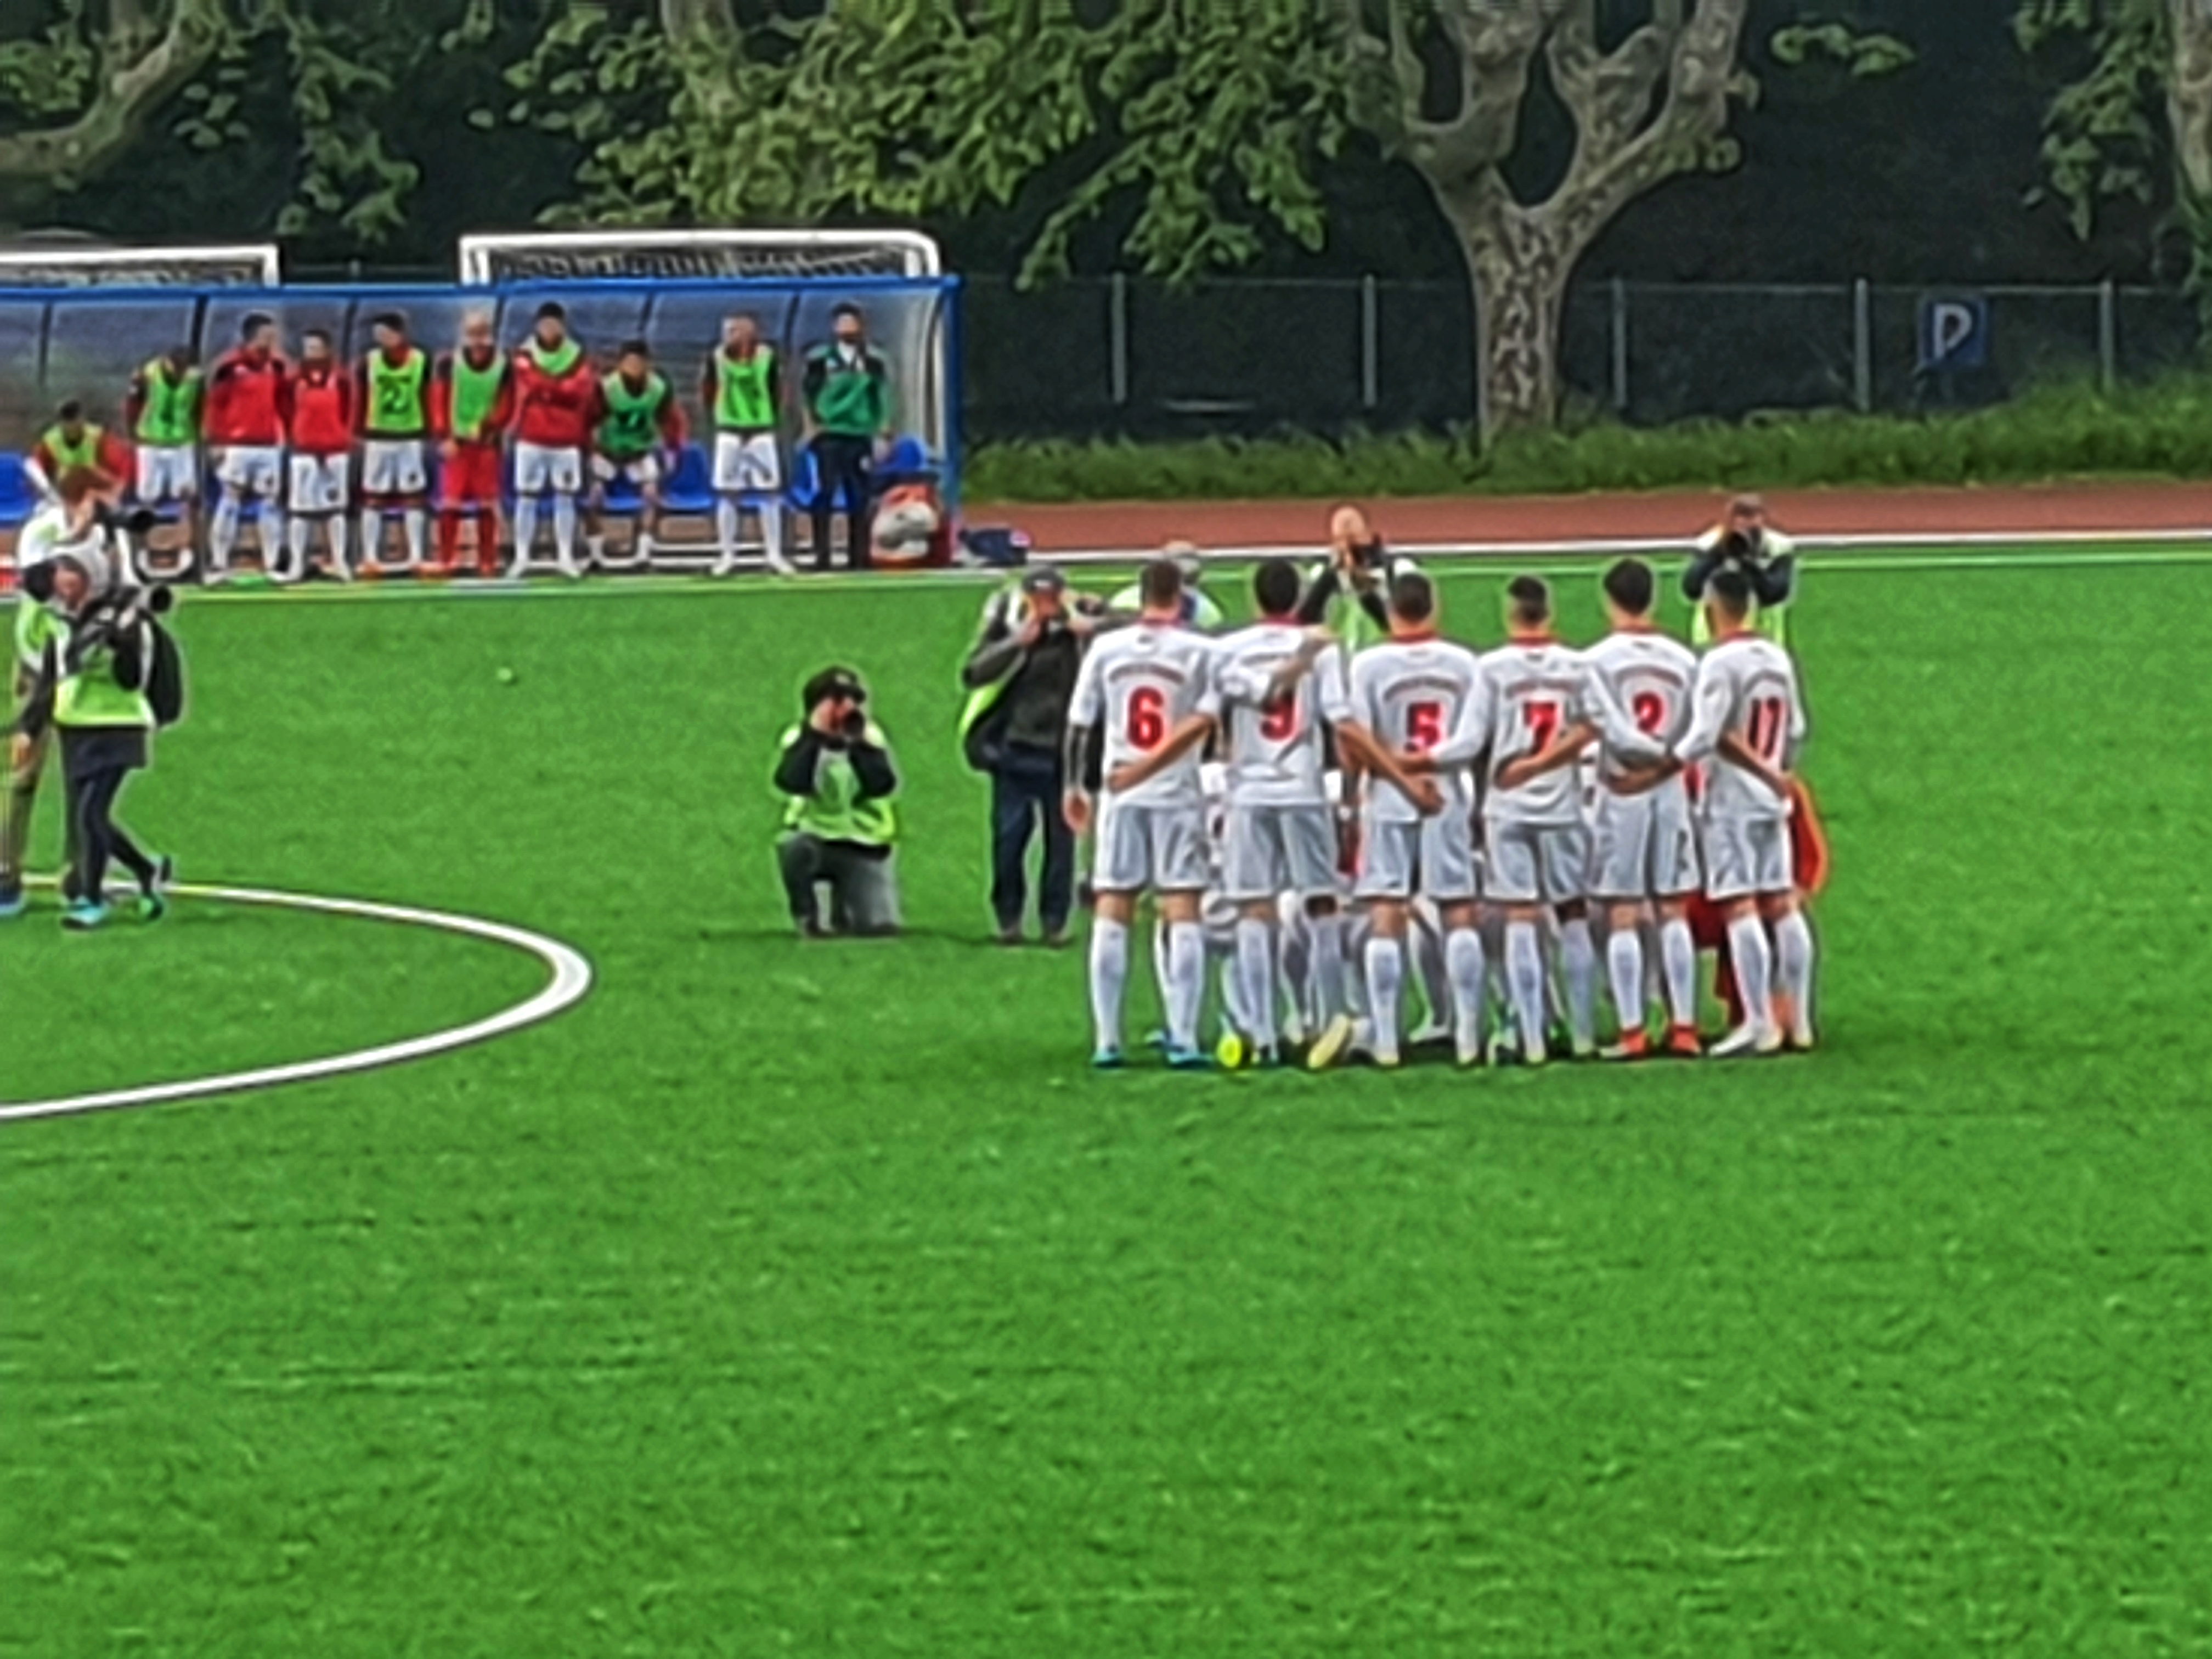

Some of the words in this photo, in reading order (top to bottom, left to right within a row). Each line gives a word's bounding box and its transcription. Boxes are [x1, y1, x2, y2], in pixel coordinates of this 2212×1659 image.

[1933, 303, 1972, 359] P
[1128, 686, 1164, 749] 6
[1405, 702, 1440, 752] 5
[1523, 702, 1556, 755] 7
[1748, 697, 1781, 759] 11
